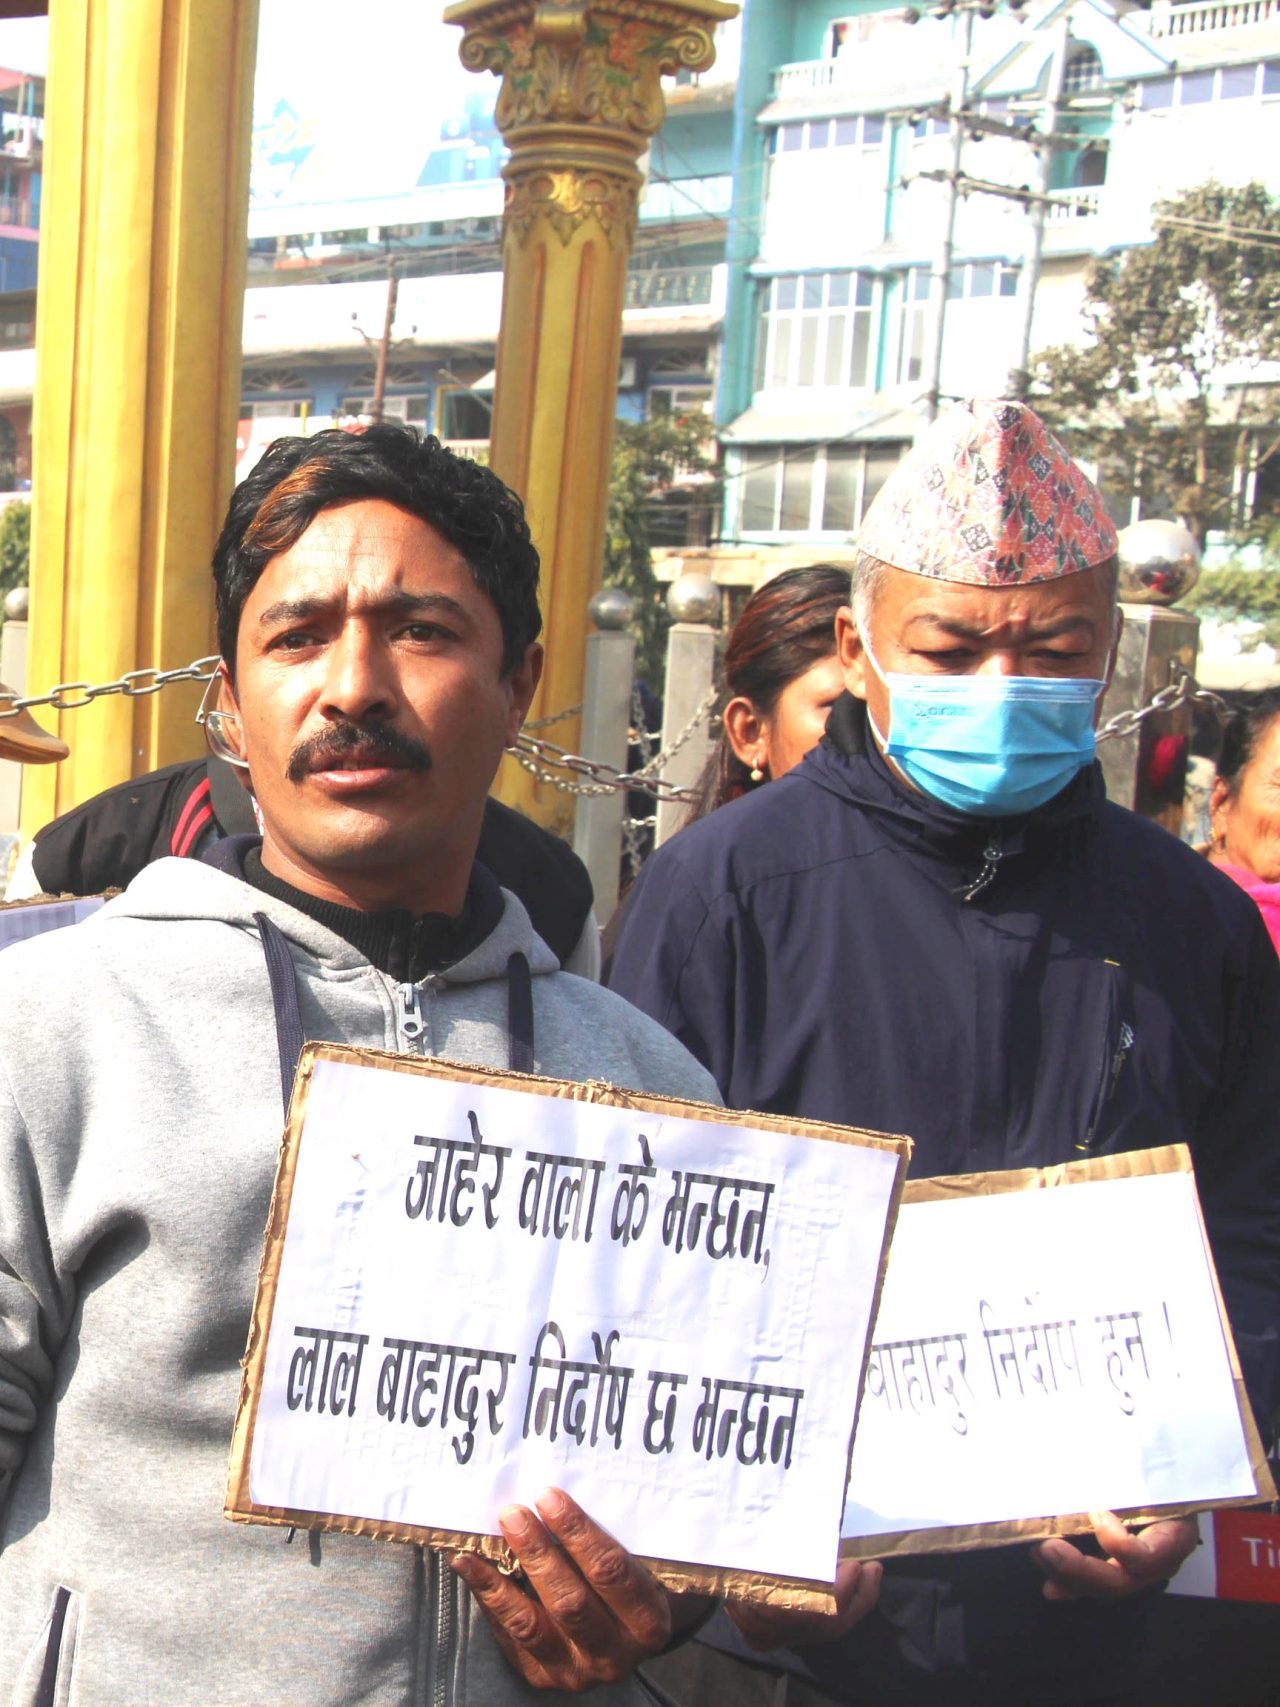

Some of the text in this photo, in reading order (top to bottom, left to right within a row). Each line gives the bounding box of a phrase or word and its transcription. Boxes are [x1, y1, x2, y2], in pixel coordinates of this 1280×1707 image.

[405, 1110, 513, 1230] जाहेर
[518, 1151, 606, 1244] वाला
[610, 1134, 658, 1248] के
[286, 1326, 370, 1418] लाल
[376, 1337, 517, 1465] बाहादुर
[522, 1321, 635, 1451] निर्दोष
[642, 1370, 689, 1455] छ
[1241, 1537, 1280, 1570] Ti
